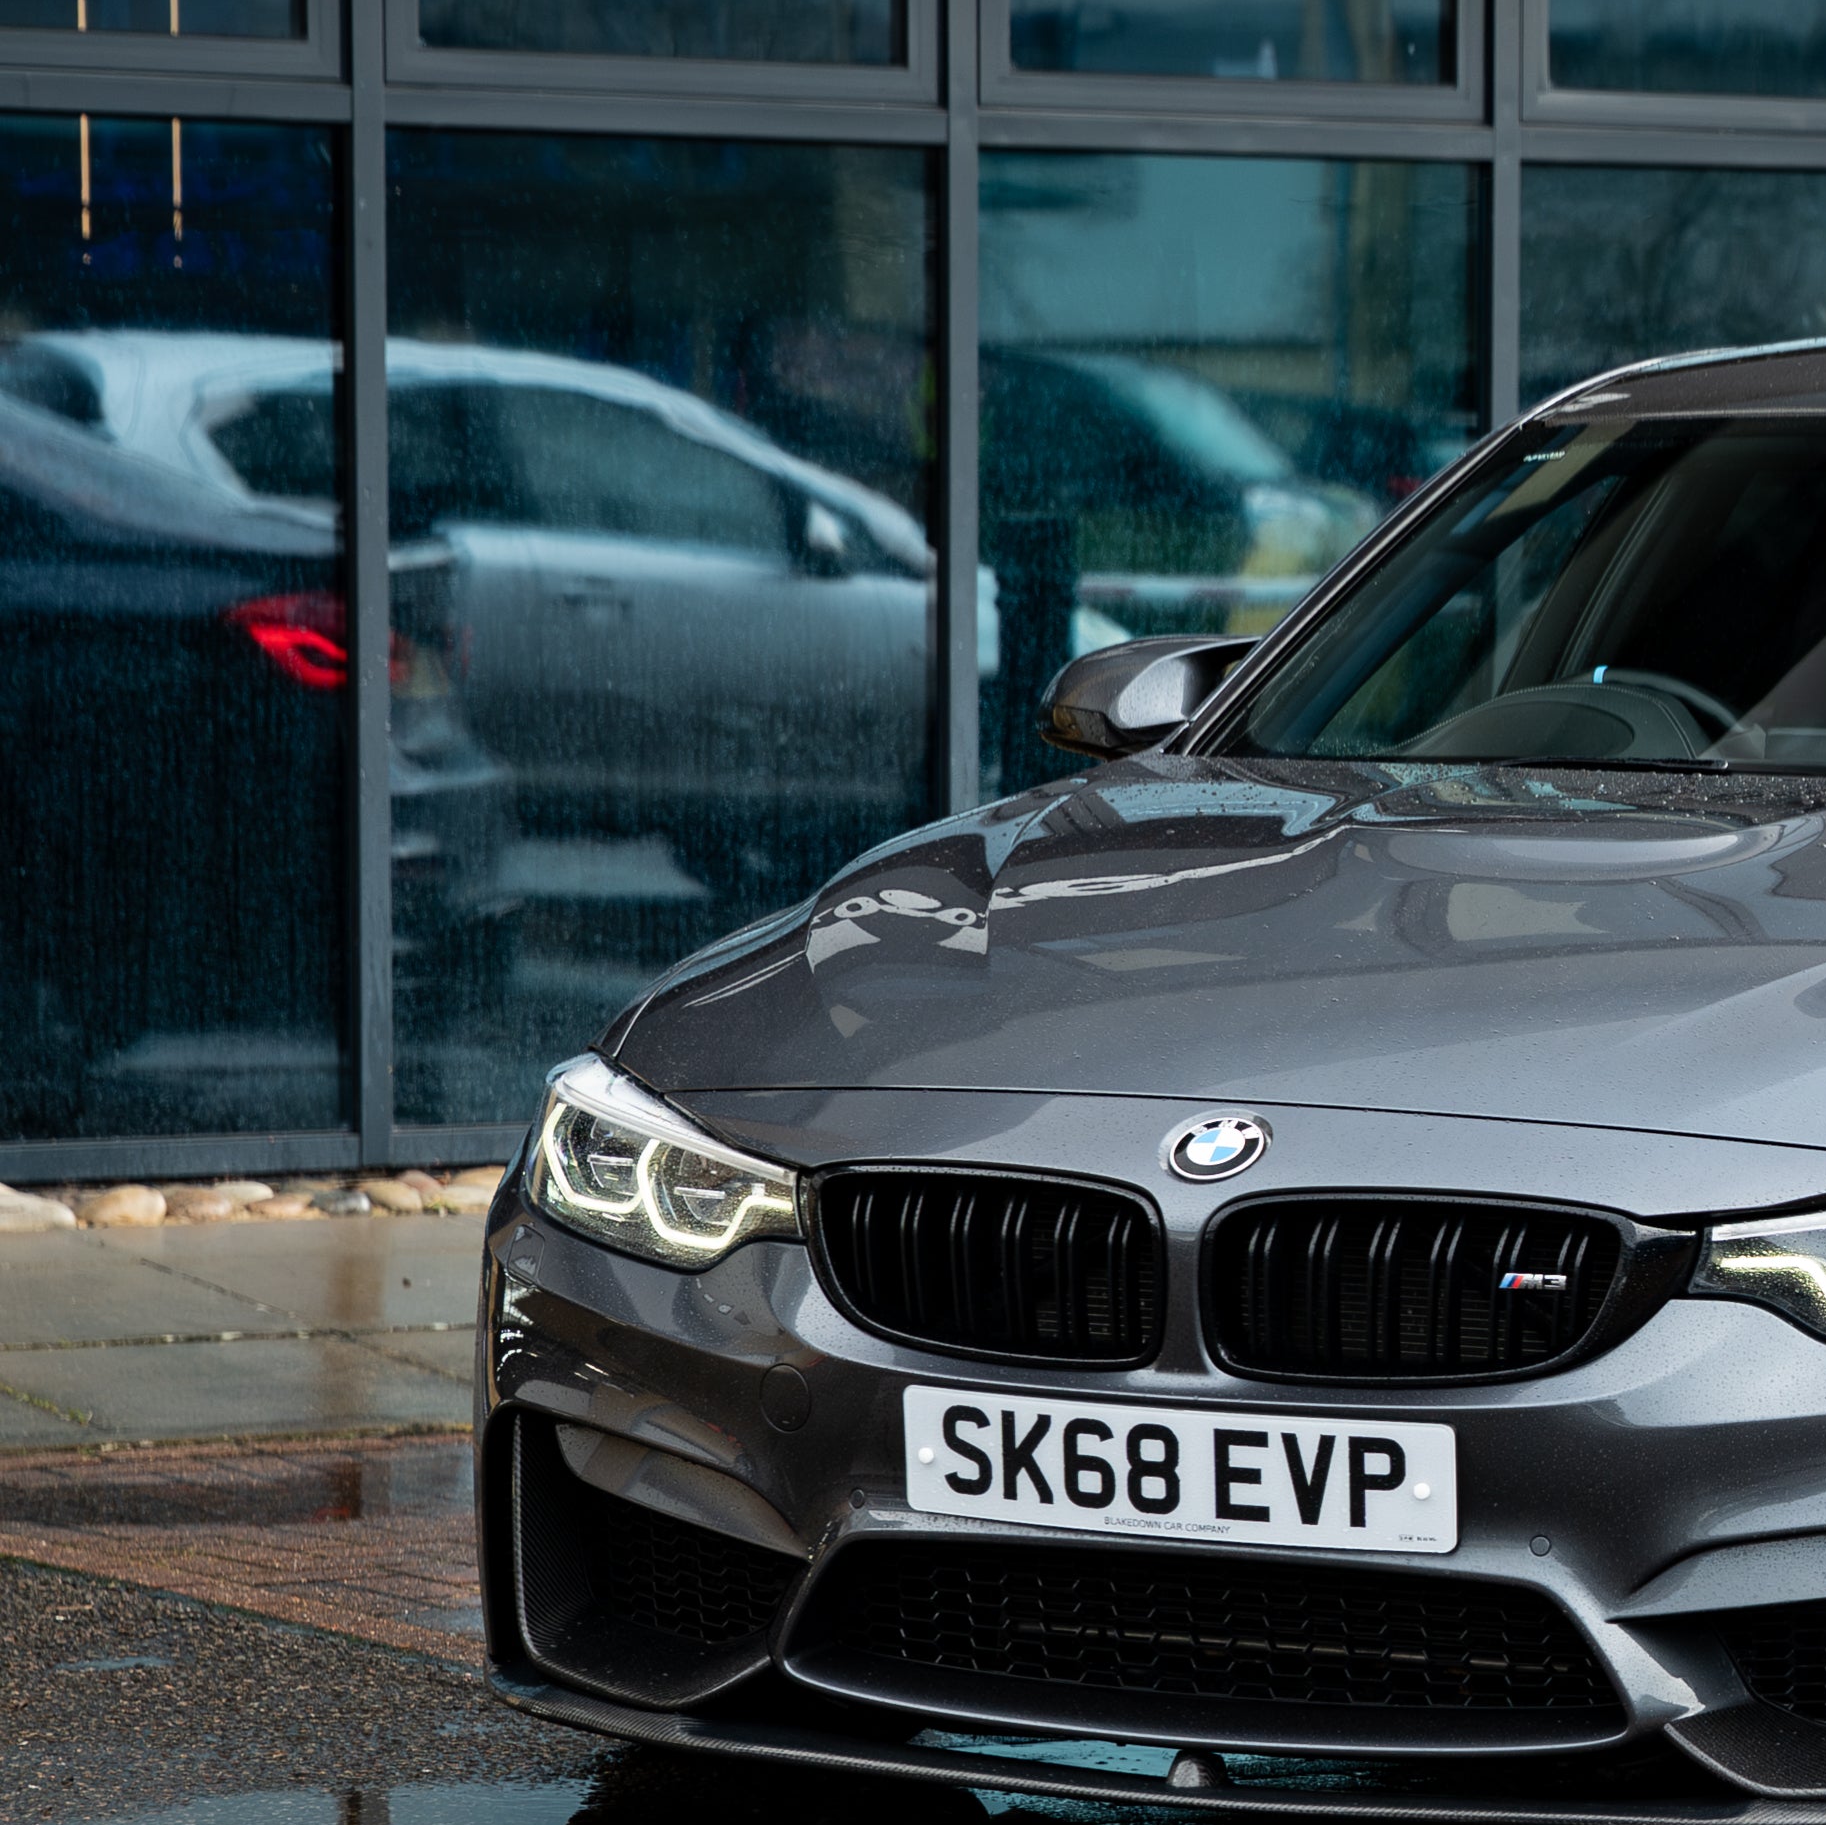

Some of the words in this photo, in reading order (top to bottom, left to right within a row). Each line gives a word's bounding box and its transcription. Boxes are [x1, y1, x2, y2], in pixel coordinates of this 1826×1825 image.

[1518, 1273, 1567, 1290] M3
[941, 1404, 1181, 1515] SK68
[1213, 1427, 1407, 1528] EVP
[1104, 1516, 1161, 1529] BLAKEDOWN
[1164, 1521, 1182, 1531] CAR
[1185, 1523, 1231, 1534] COMPANY
